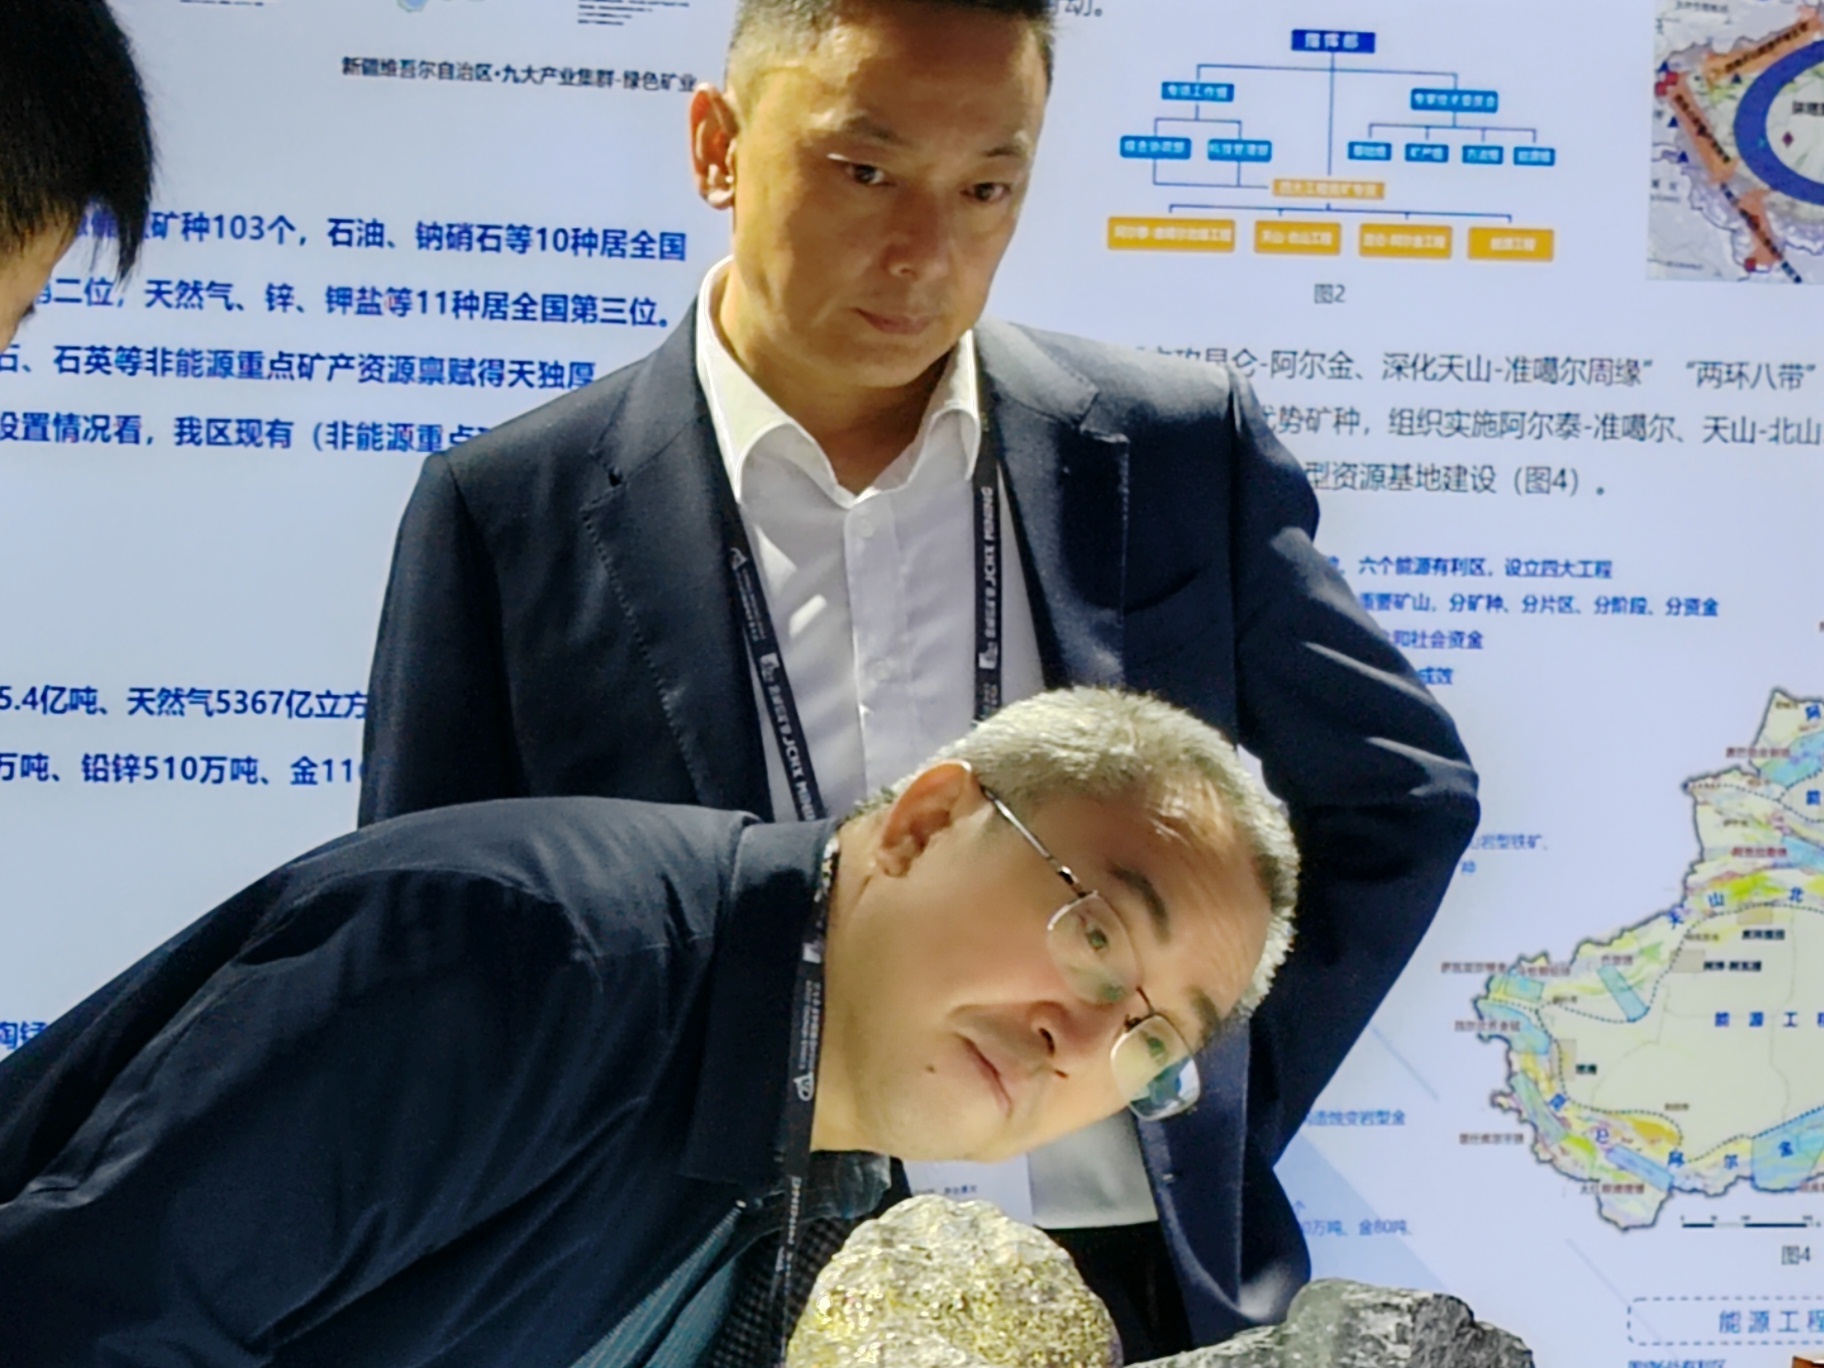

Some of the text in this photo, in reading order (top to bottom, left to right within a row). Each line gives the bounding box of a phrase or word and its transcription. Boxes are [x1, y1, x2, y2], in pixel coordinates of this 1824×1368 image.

[78, 206, 686, 262] 矿种103个，石油、钠硝石等10种居全国
[1314, 283, 1346, 304] 图2
[1781, 1245, 1811, 1265] 图4
